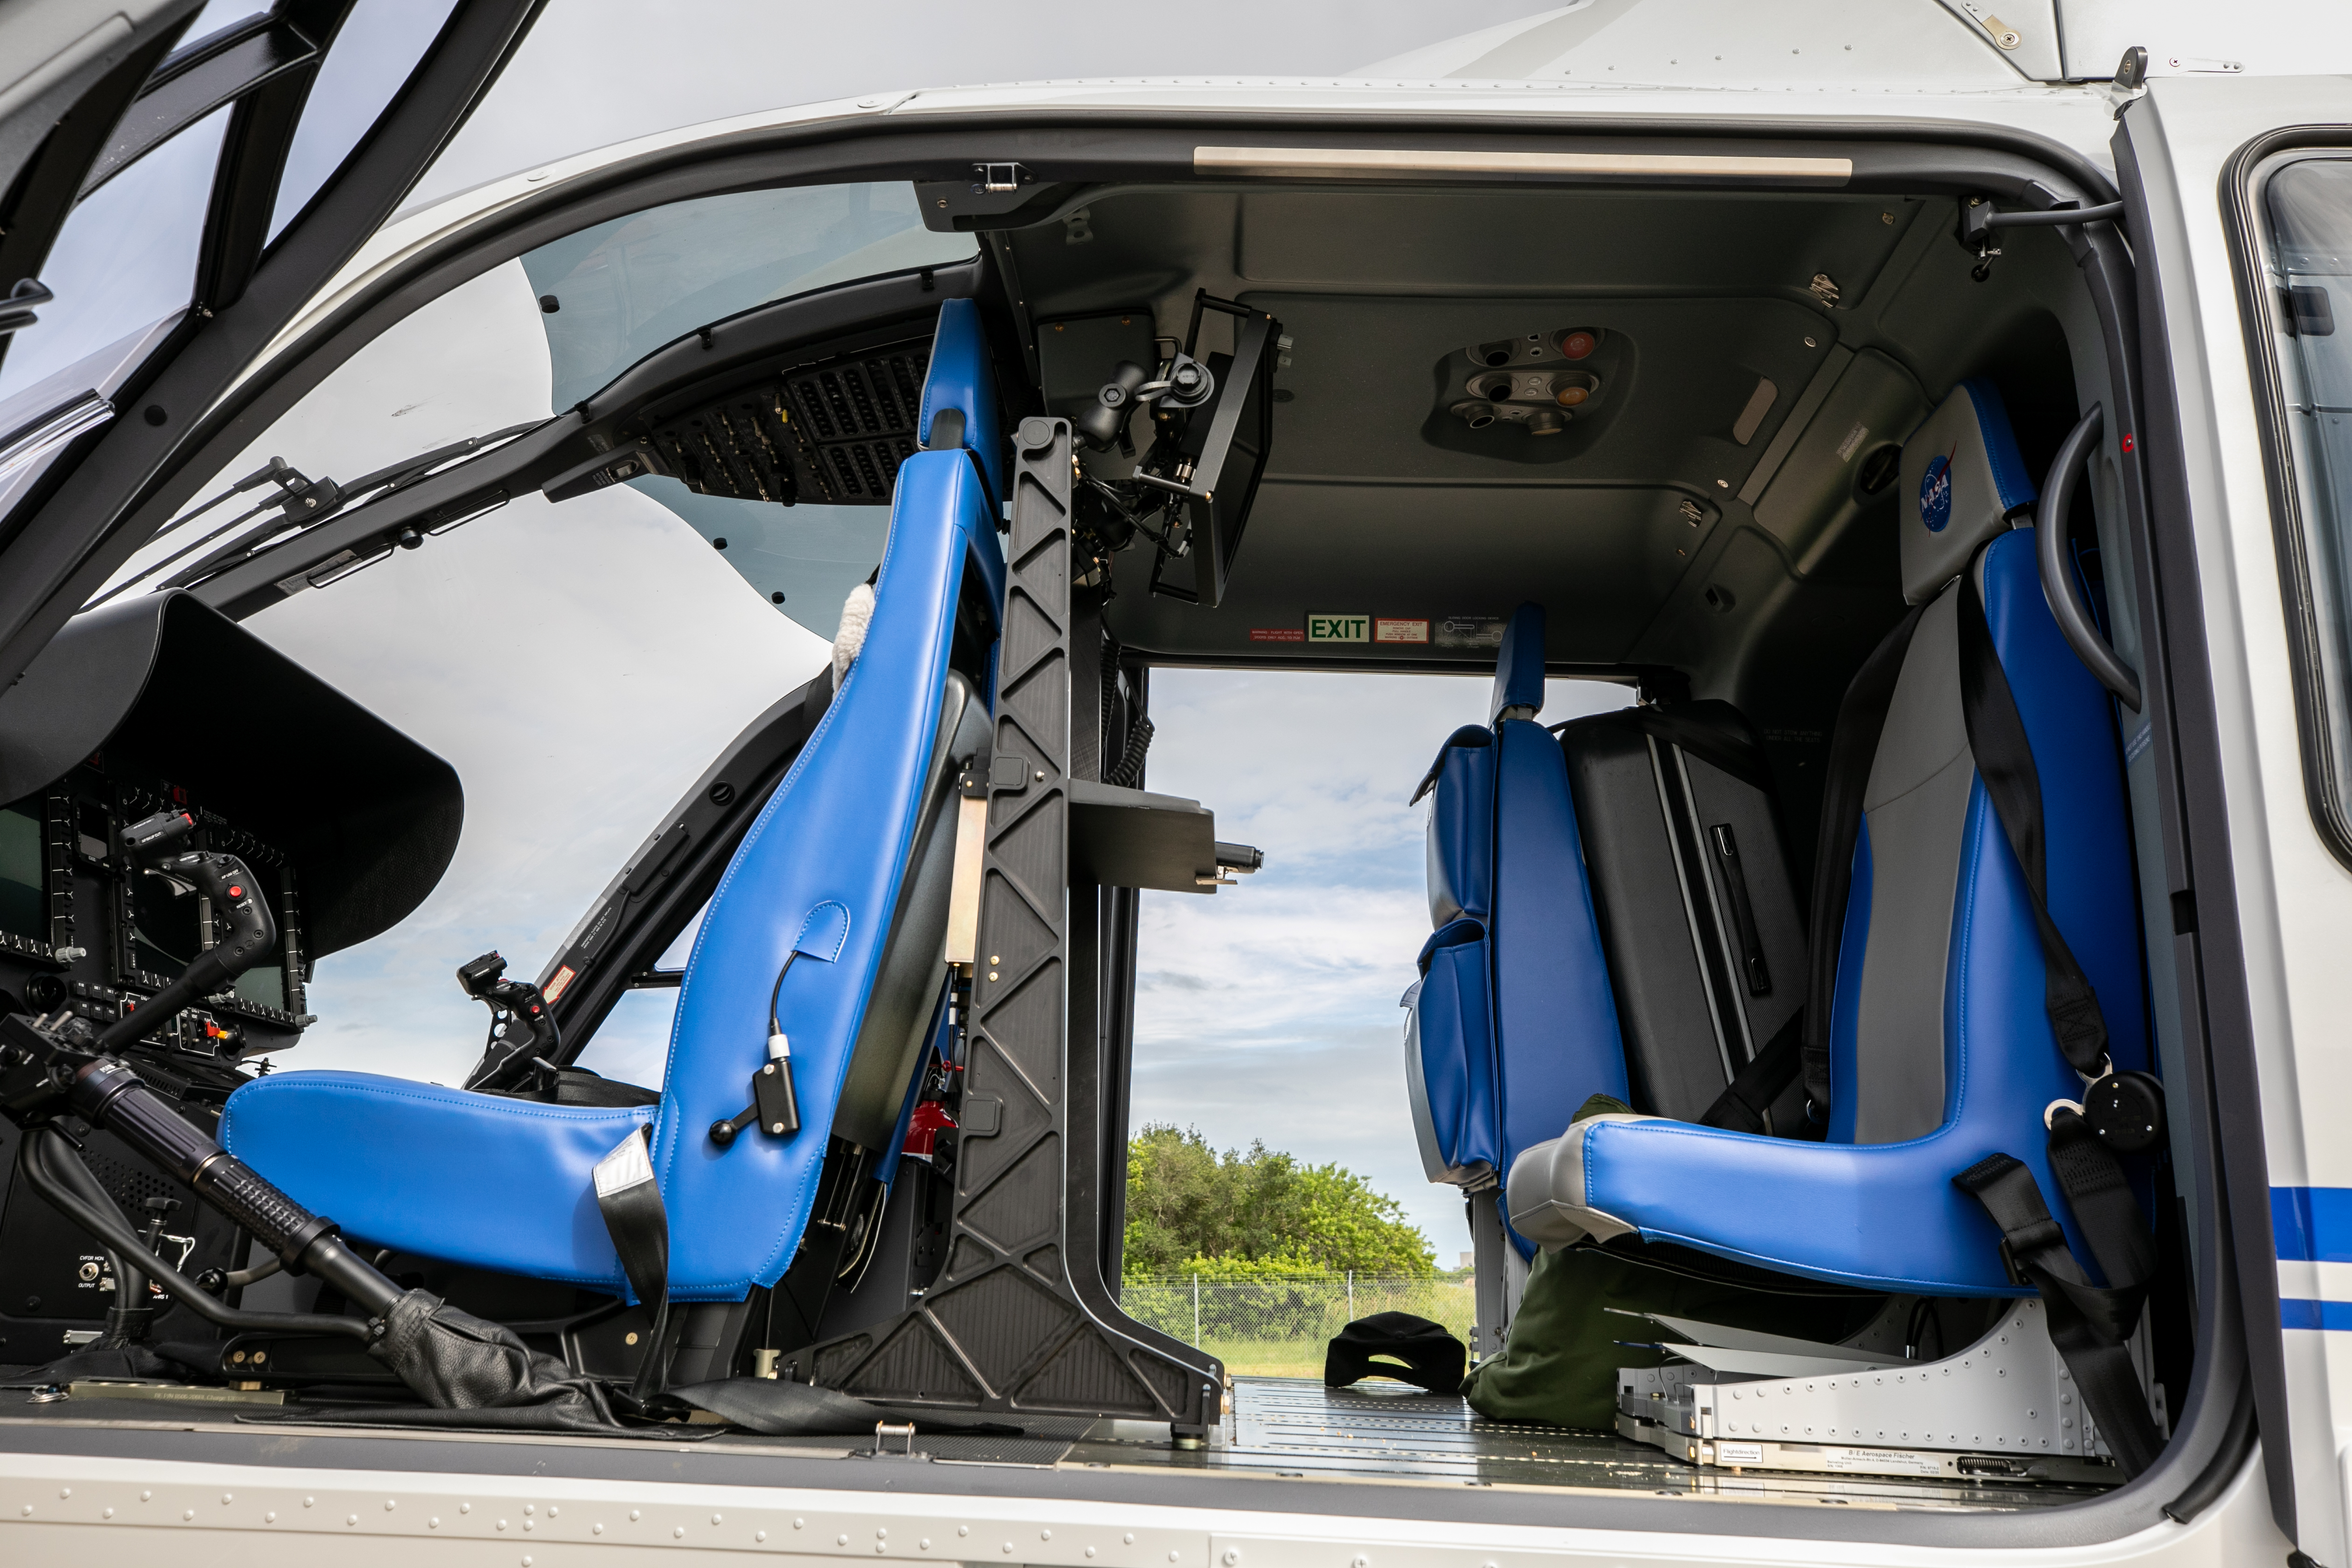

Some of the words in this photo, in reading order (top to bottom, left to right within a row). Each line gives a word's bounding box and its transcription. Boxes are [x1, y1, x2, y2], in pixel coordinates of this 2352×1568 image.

[1921, 474, 1949, 513] NASA
[1311, 619, 1366, 638] EXIT
[555, 969, 566, 982] JETTISON
